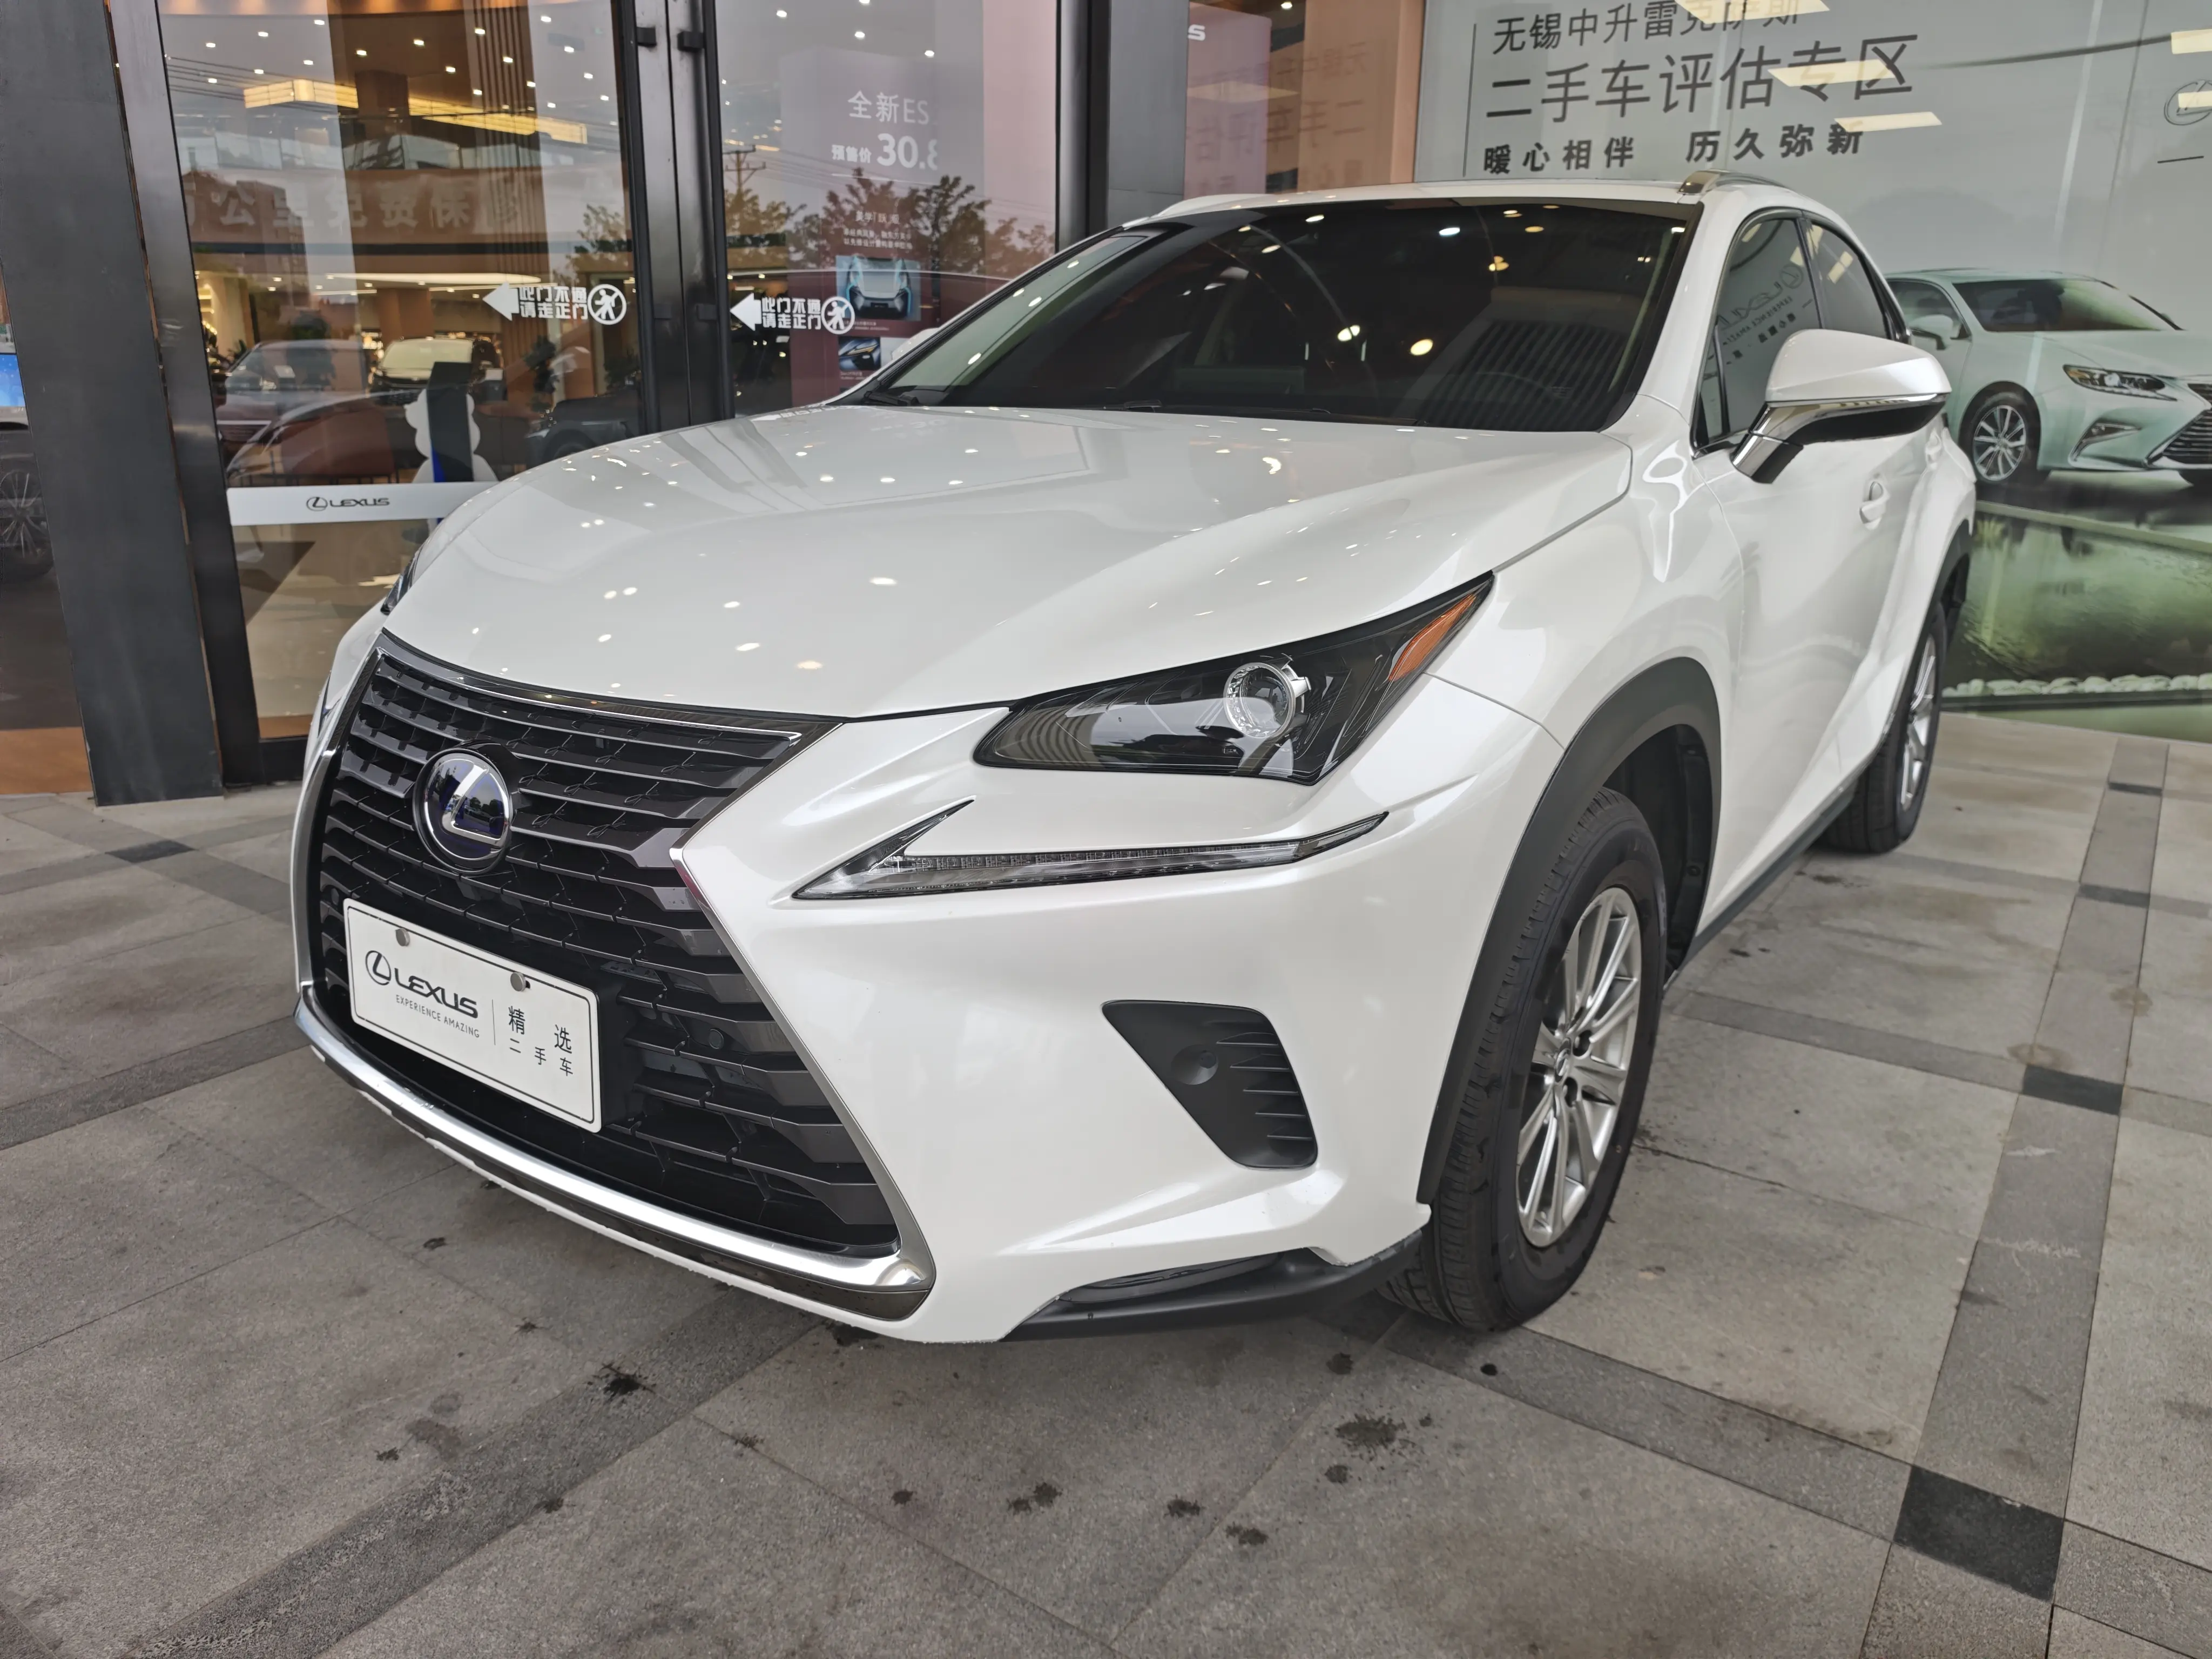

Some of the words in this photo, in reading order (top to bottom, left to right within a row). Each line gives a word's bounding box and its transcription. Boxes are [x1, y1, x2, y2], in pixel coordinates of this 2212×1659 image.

[1486, 33, 1918, 123] 二手车评估专区
[1483, 136, 1635, 176] 暖心相伴
[1684, 123, 1864, 163] 历久弥新
[519, 286, 587, 303] 此门不通
[520, 301, 589, 320] 请走正门
[761, 296, 821, 314] 此门不通
[762, 313, 822, 330] 请走正门
[329, 498, 390, 508] LEXUS
[394, 967, 478, 1019] LEXUS
[395, 994, 441, 1022] EXPERIENCE
[444, 1016, 480, 1038] AMAZING
[508, 1005, 572, 1054] 精选
[509, 1037, 574, 1077] 二手车
